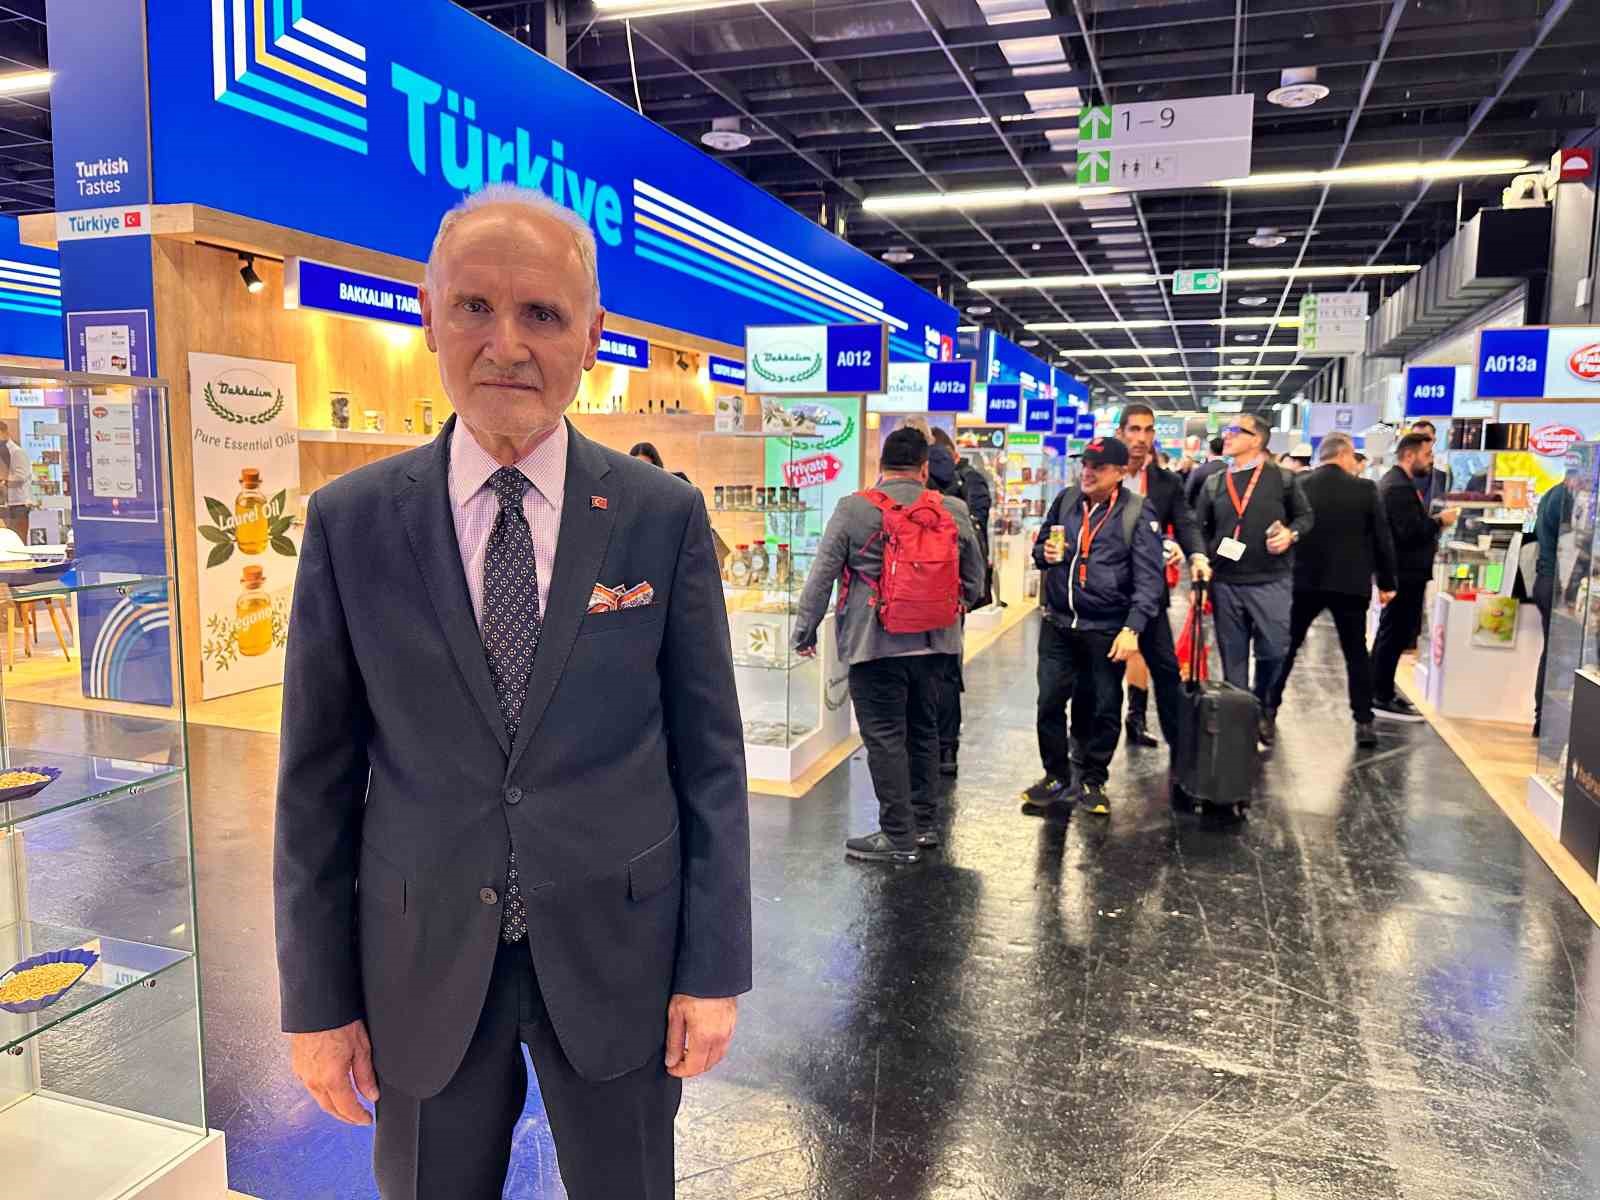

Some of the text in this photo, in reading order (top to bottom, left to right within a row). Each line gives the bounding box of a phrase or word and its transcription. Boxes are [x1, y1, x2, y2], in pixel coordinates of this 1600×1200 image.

[391, 62, 622, 246] Türkiye
[75, 157, 129, 178] Turkish
[76, 179, 121, 197] Tastes
[68, 213, 120, 234] Türkiye
[339, 282, 394, 311] BAKKALIM
[837, 350, 872, 367] A012
[1484, 355, 1537, 373] A013a
[933, 380, 966, 394] A012a
[1414, 384, 1446, 399] A013
[194, 427, 296, 451] Pure Essential Oils
[786, 459, 828, 477] Private
[262, 498, 281, 519] Oil
